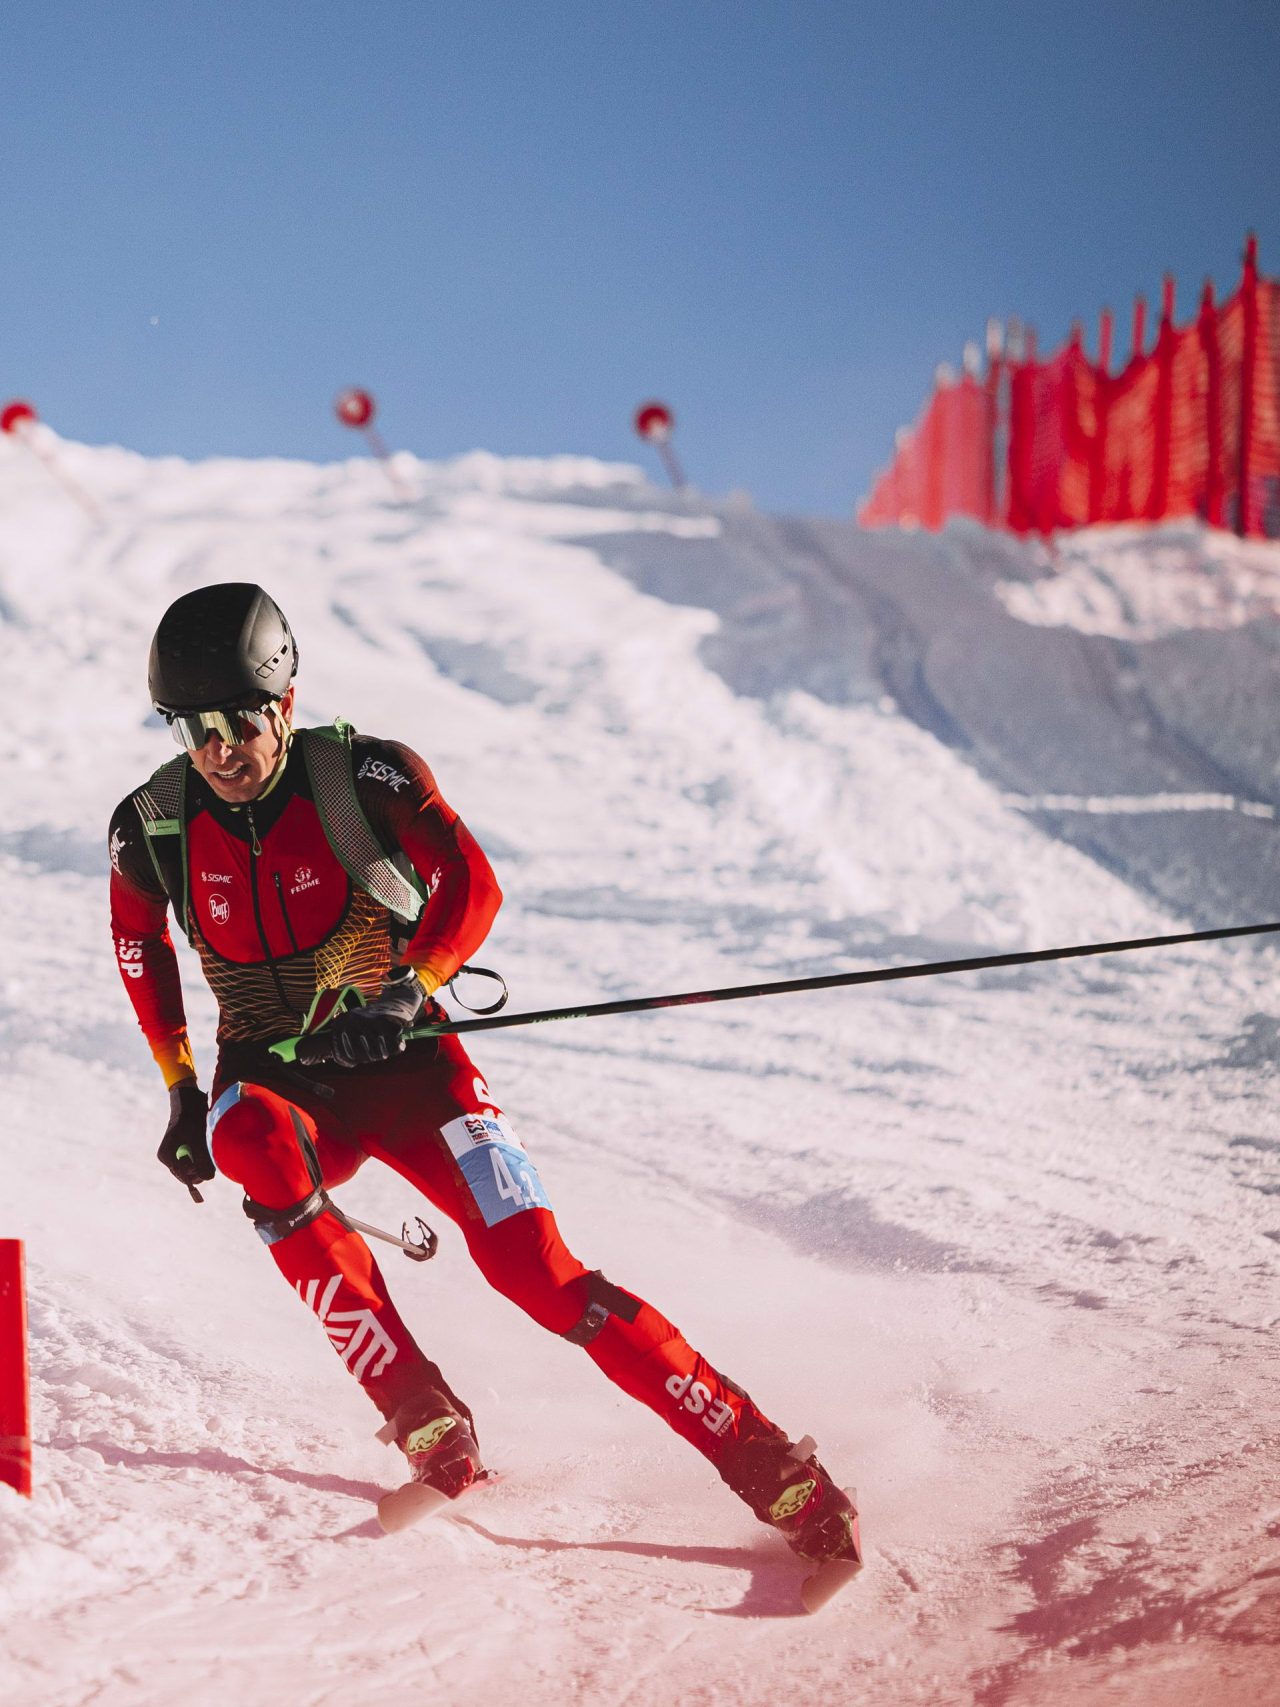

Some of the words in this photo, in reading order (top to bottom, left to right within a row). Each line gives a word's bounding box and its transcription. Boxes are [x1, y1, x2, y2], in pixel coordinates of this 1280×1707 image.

[366, 761, 410, 793] SISMIC
[207, 872, 233, 884] SISMIC
[290, 878, 322, 895] FEDME
[665, 1373, 733, 1434] ESP
